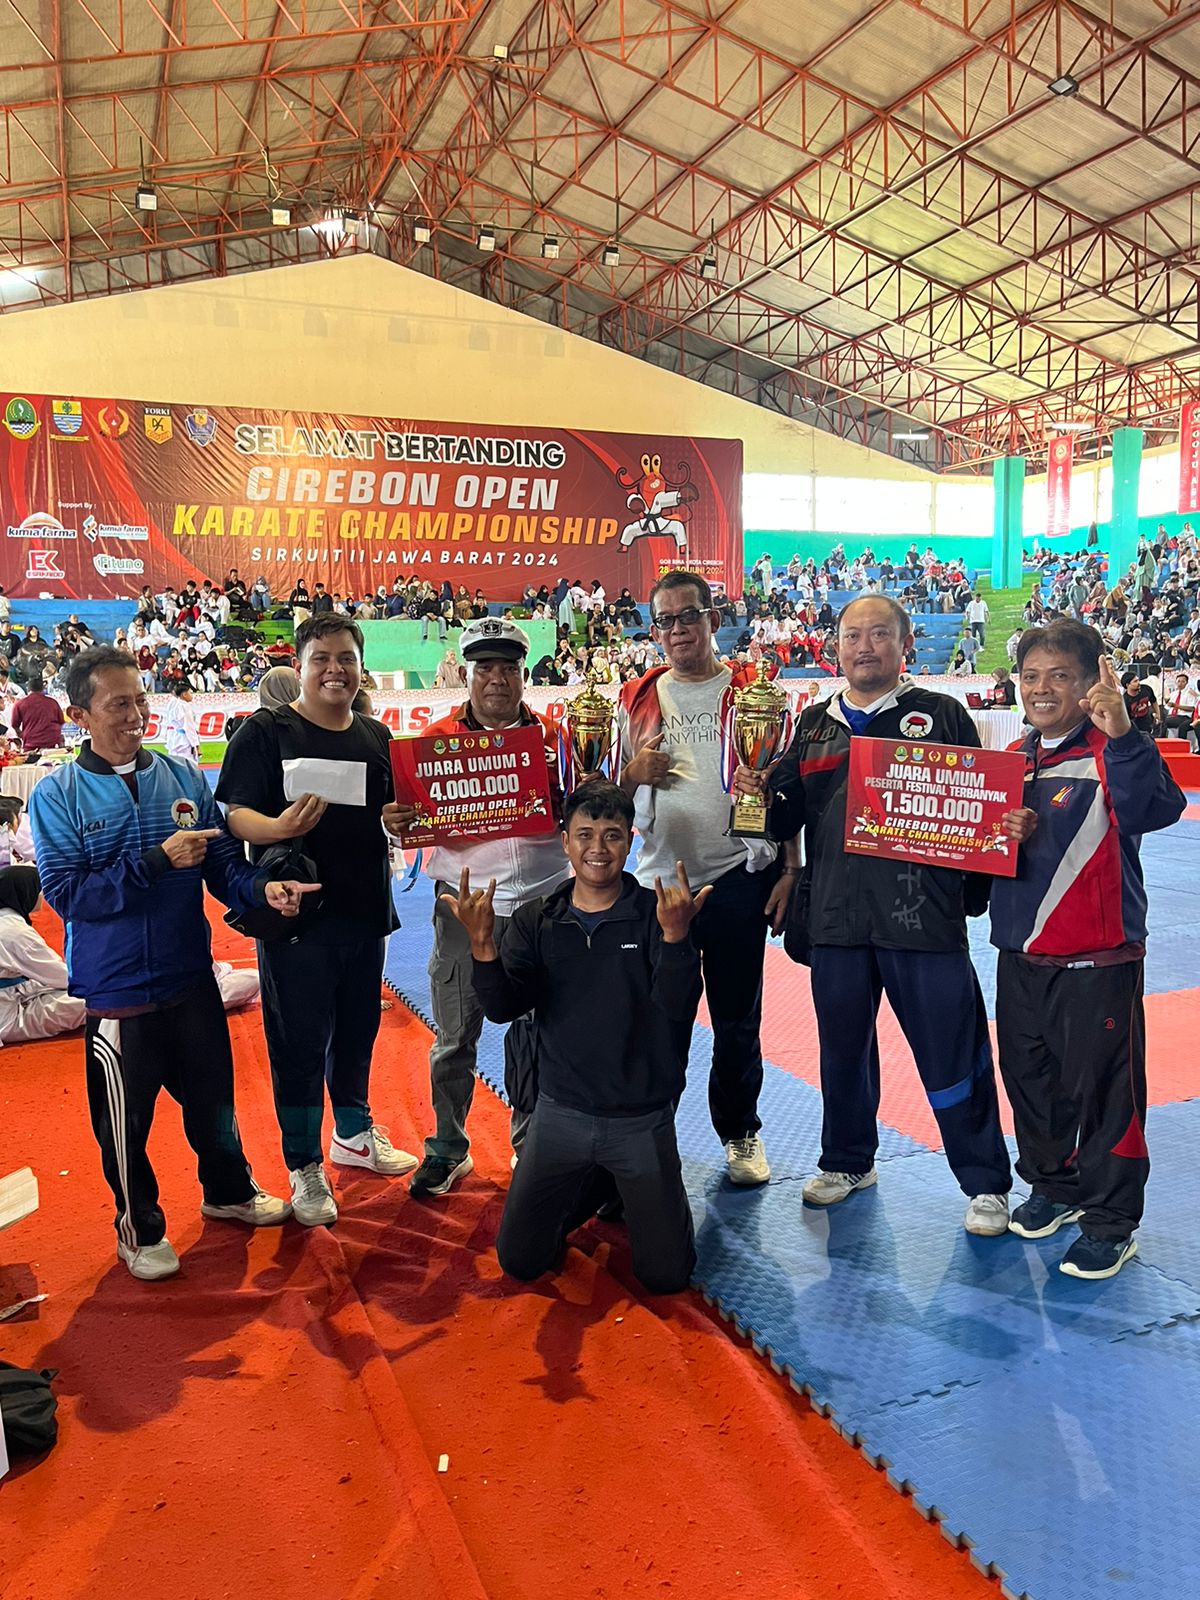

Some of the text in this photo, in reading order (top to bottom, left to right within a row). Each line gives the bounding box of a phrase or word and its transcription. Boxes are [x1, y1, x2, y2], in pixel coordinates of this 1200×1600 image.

[145, 407, 170, 415] FORKI
[235, 425, 565, 469] SELAMAT BERTANDING
[246, 466, 559, 510] CIREBON OPEN
[8, 525, 76, 537] kimia farma
[173, 504, 618, 544] KARATE CHAMPIONSHIP
[251, 548, 559, 566] SIRKUIT II JAWA BARAT 2024
[660, 712, 722, 730] ANYON
[701, 724, 713, 732] be
[661, 729, 722, 745] ANYTHIN
[415, 752, 530, 778] JUARA UMUM 3
[886, 764, 985, 788] JUARA UMUM
[429, 773, 520, 801] 4.000.000
[864, 777, 1007, 803] PESERTA FESTIVAL TERBANYAK
[420, 805, 534, 826] KARATE CHAMPIONSHIP
[436, 798, 517, 816] CIREBON OPEN
[881, 791, 983, 824] 1.500.000
[866, 824, 995, 847] KARATE CHAMPIONSHIP
[884, 817, 976, 838] CIREBON OPEN
